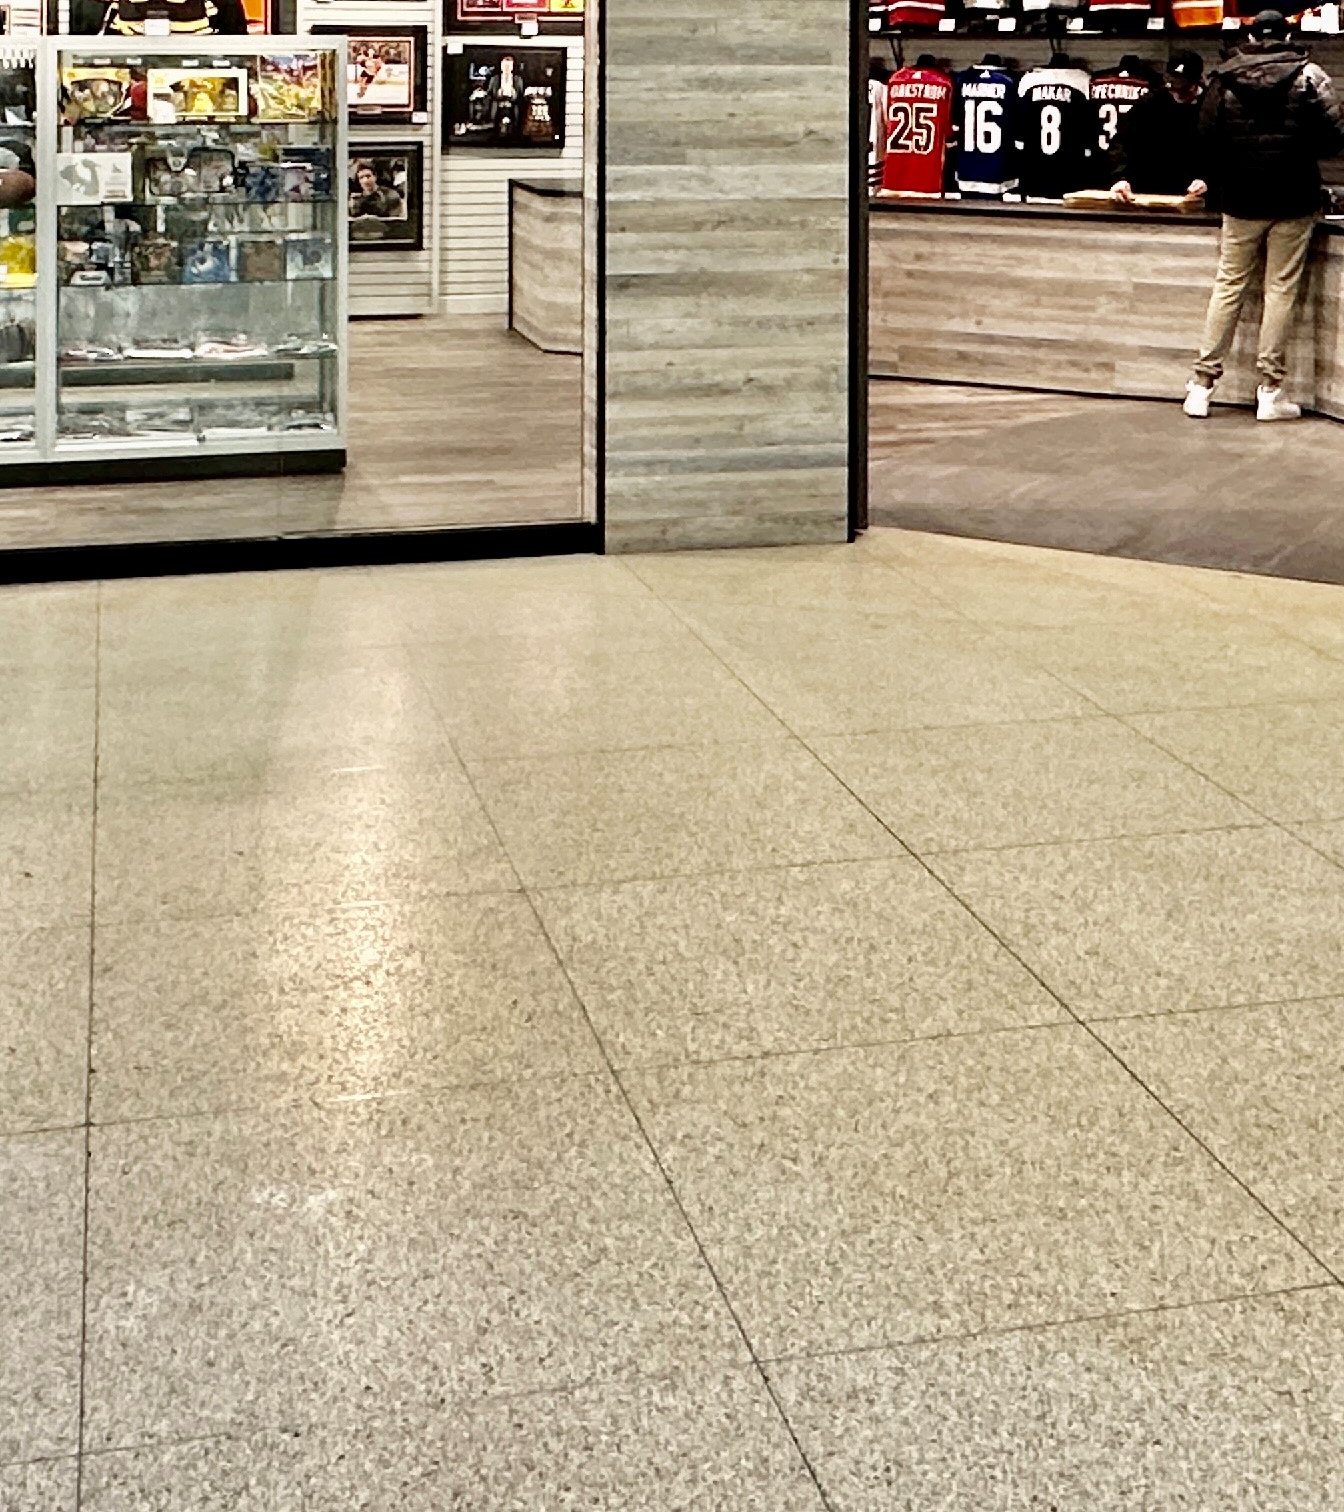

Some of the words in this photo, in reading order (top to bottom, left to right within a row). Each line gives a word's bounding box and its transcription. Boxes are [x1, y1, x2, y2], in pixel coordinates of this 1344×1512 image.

[1032, 85, 1072, 103] MAKAR
[887, 101, 938, 155] 25
[964, 99, 1004, 154] 16
[1040, 105, 1062, 156] 8
[1098, 103, 1134, 151] 3
